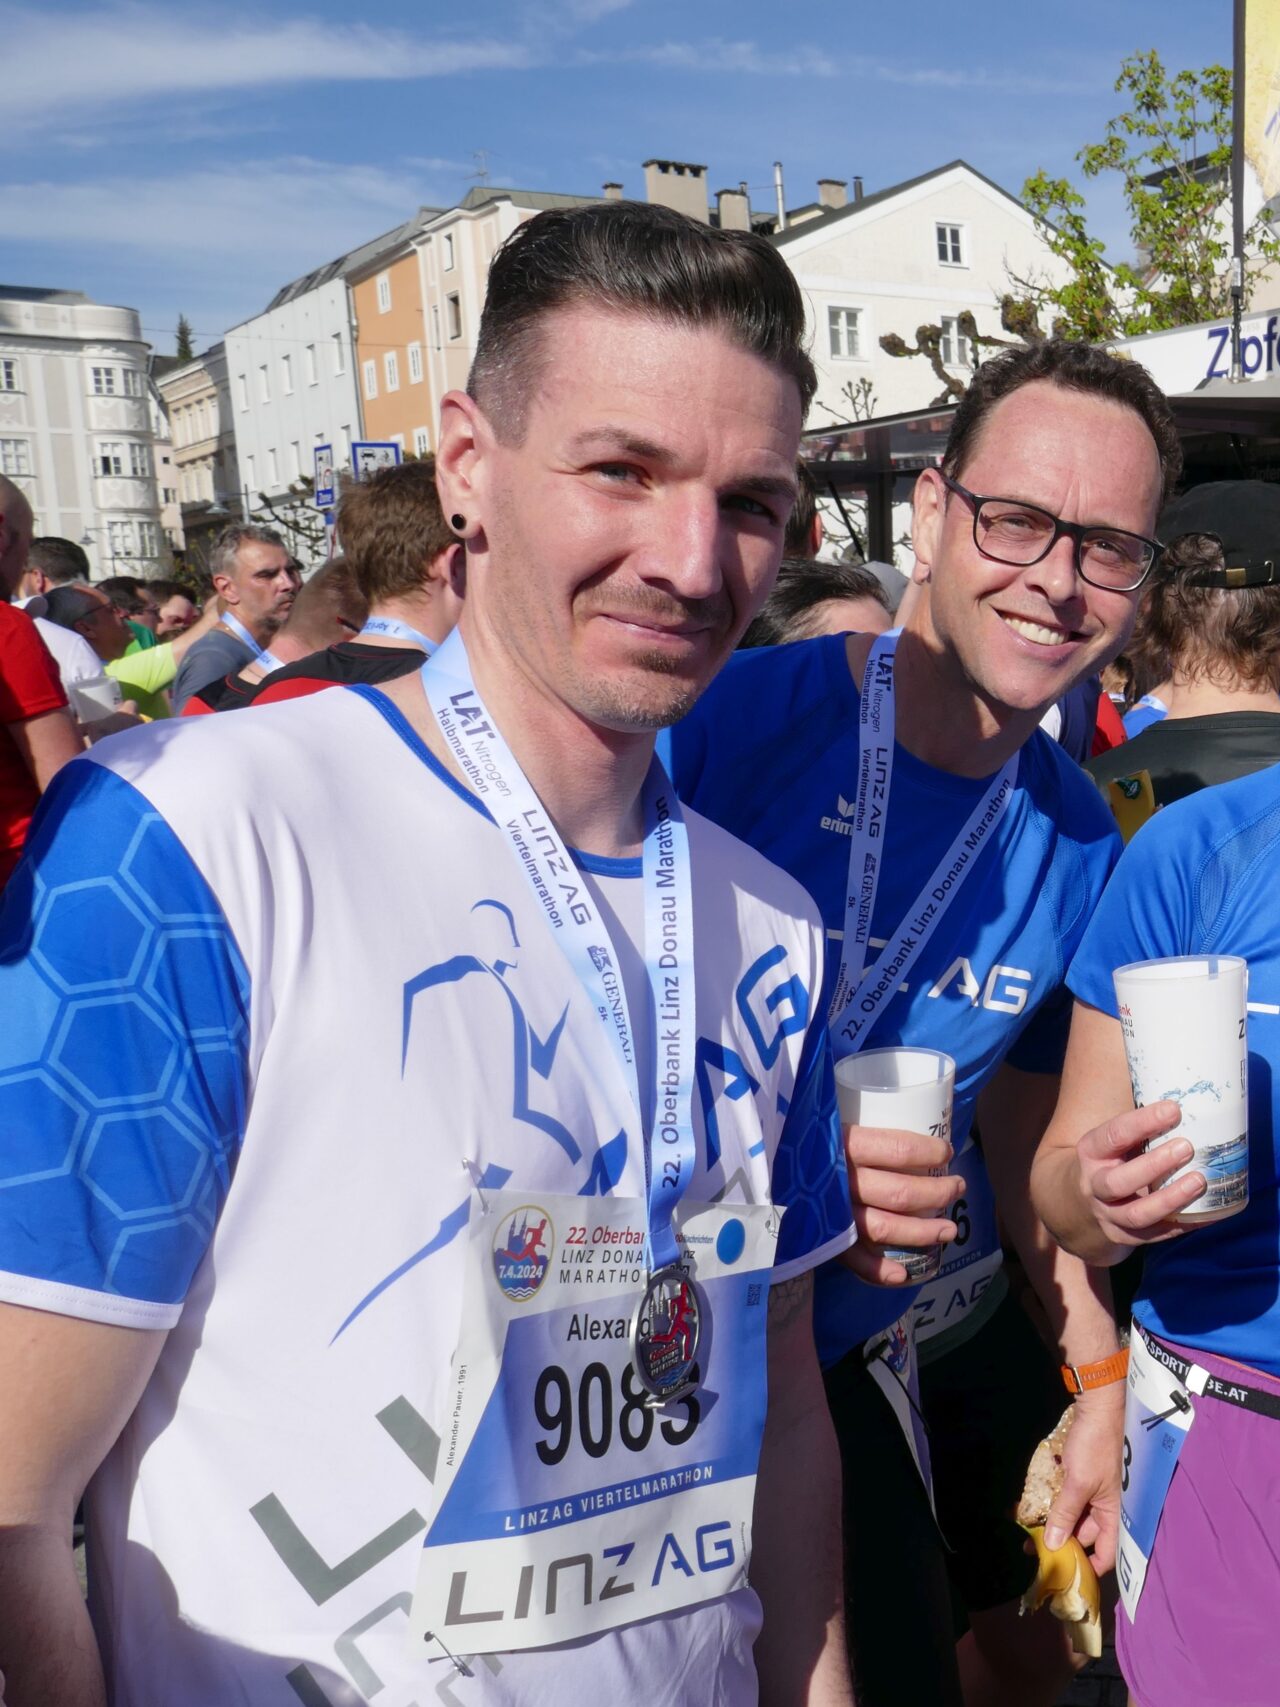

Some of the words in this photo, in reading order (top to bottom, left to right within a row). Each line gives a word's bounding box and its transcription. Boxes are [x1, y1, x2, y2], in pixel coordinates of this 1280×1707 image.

[860, 659, 876, 725] Halbmarathon
[875, 653, 895, 692] LAT
[449, 690, 497, 738] LAT
[872, 688, 884, 733] Nitrogen
[437, 708, 490, 793] Halbmarathon
[472, 741, 512, 798] Nitrogen
[872, 747, 888, 801] LINZ
[855, 749, 872, 832] Viertelmarathon
[656, 797, 677, 889] Marathon
[820, 815, 853, 836] erim
[868, 807, 883, 839] AG
[507, 819, 563, 928] Viertelmarathon
[522, 809, 569, 877] LINZ
[559, 881, 592, 926] AG
[841, 1019, 865, 1041] 22.
[864, 937, 917, 1013] Oberbank
[910, 905, 938, 941] Linz
[932, 849, 970, 900] Donau
[966, 778, 1011, 850] Marathon
[847, 896, 854, 909] 5k
[855, 875, 874, 944] GENERALI
[659, 895, 678, 969] Donau
[598, 1006, 608, 1022] 5k
[660, 976, 680, 1021] Linz
[928, 956, 1031, 1015] AG
[601, 972, 632, 1064] GENERALI
[660, 1028, 680, 1143] Oberbank
[662, 1153, 681, 1188] 22.
[561, 1249, 595, 1264] LINZ
[602, 1249, 644, 1264] DONA
[565, 1227, 589, 1245] 22.
[592, 1226, 645, 1245] Oberba
[499, 1264, 543, 1280] 7.4.2024
[560, 1269, 641, 1285] MARATHO
[446, 1420, 460, 1467] Alexander
[458, 1364, 467, 1385] 1991
[505, 1504, 573, 1531] LINZAG
[581, 1465, 713, 1512] VIERTELMARATHON
[444, 1542, 636, 1626] LINZ
[650, 1520, 735, 1587] AG
